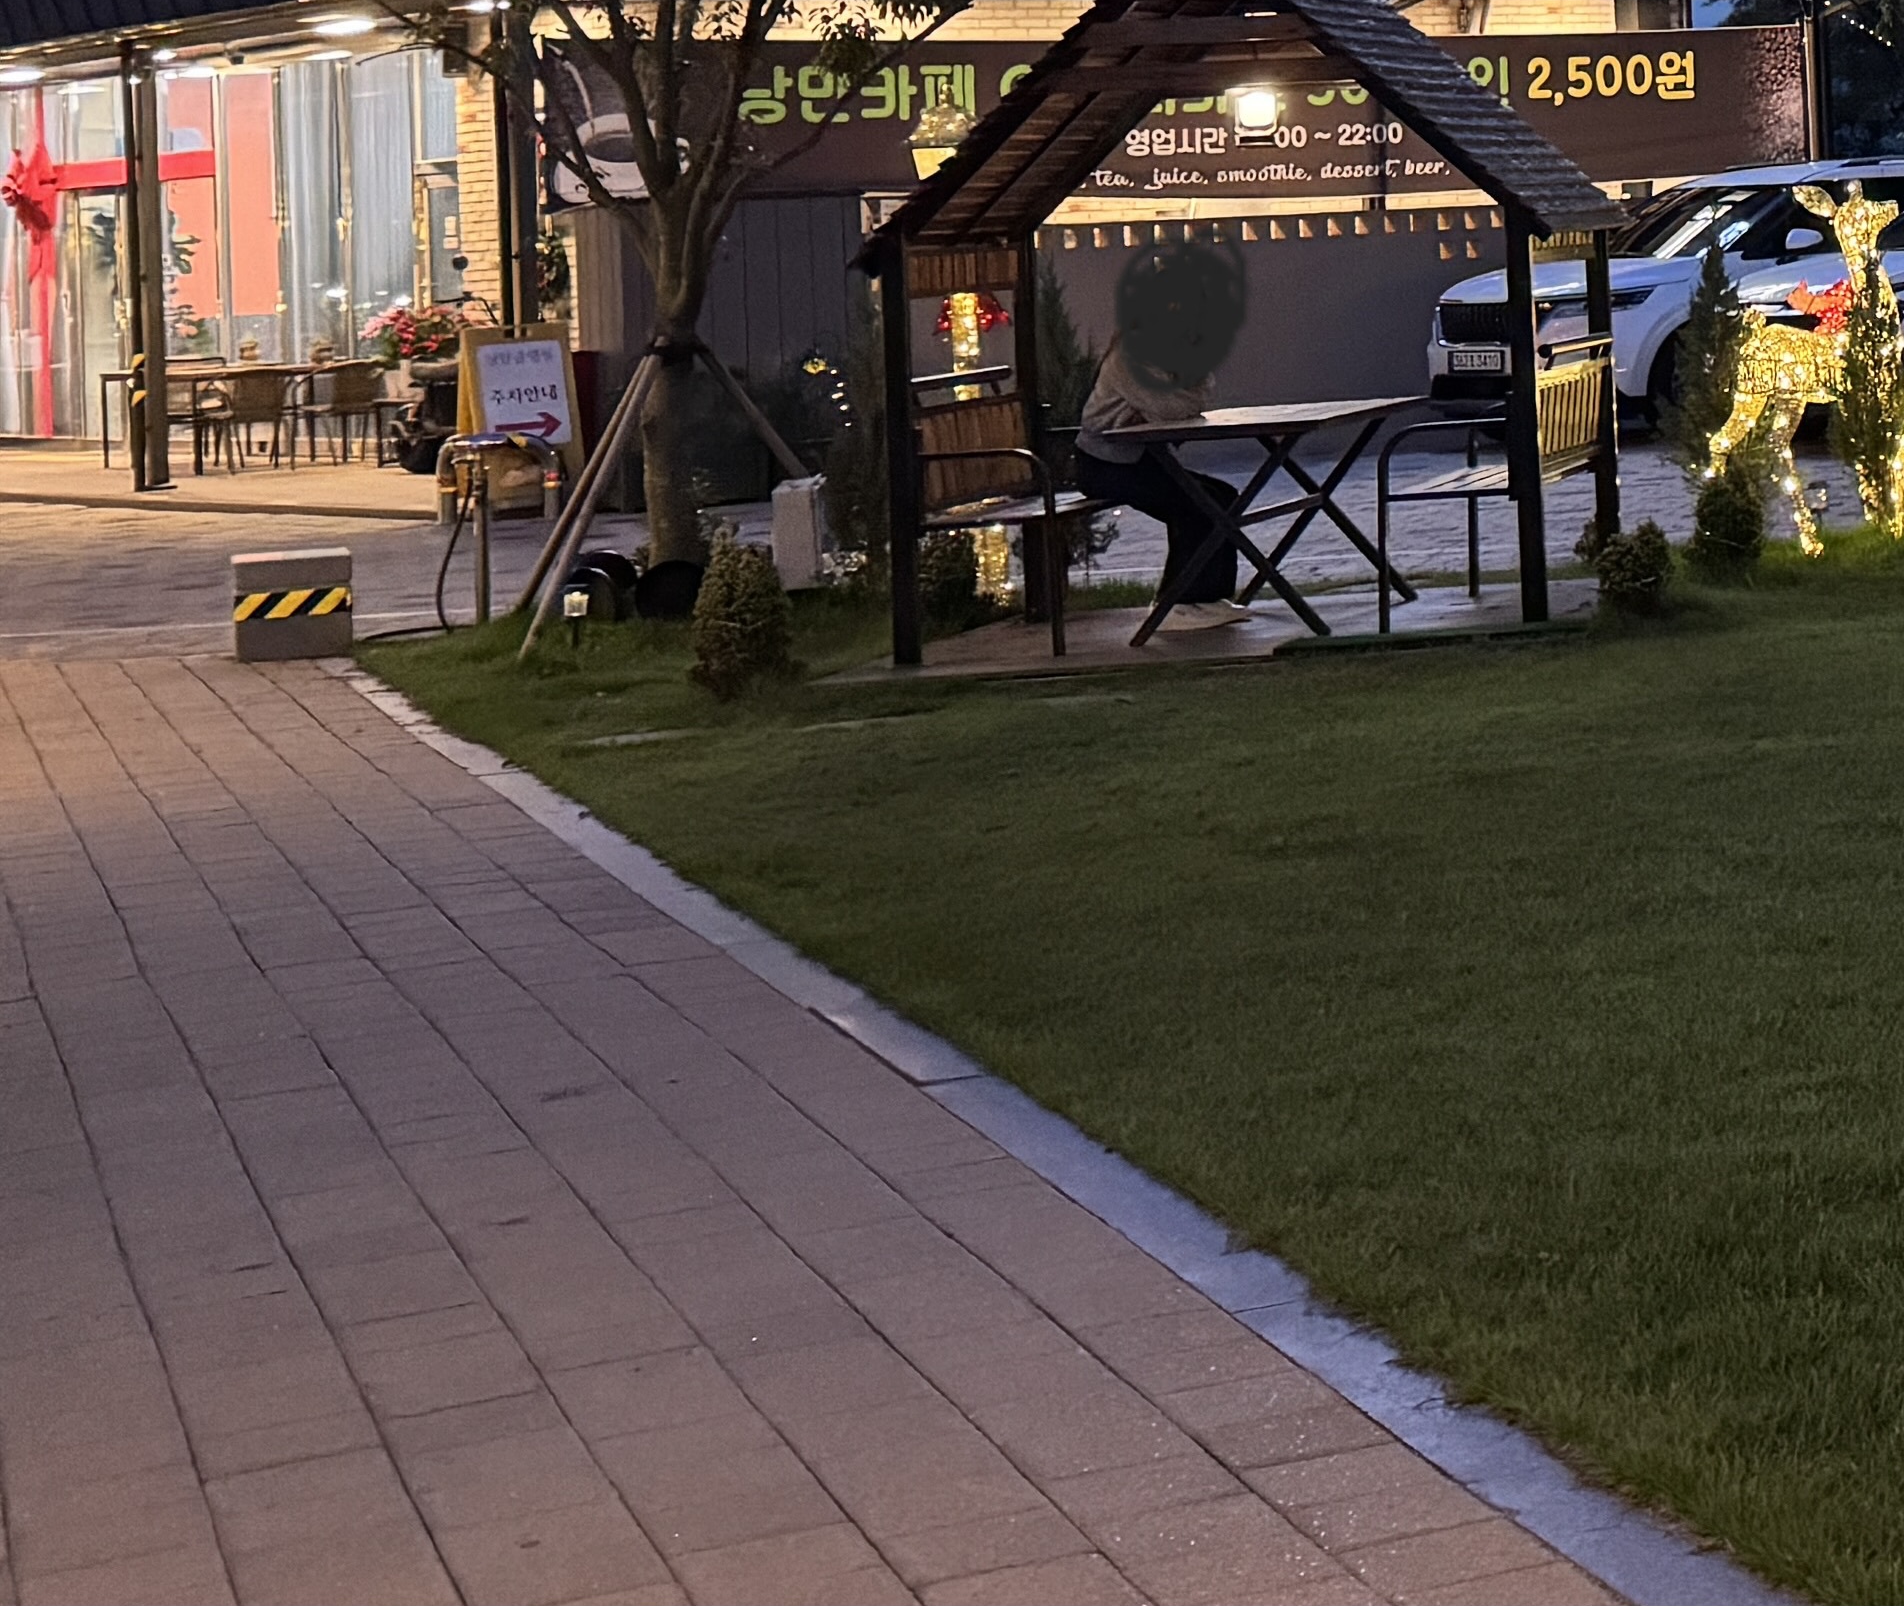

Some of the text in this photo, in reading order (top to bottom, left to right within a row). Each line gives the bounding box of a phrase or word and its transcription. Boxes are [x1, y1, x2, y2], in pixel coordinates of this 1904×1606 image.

[738, 64, 976, 124] 낭만카페
[1527, 50, 1695, 106] 2,500원
[1125, 127, 1228, 157] 영업시간
[1337, 122, 1403, 147] 22:00
[1143, 167, 1209, 190] juice,
[1217, 163, 1312, 184] smoothie,
[1404, 159, 1450, 176] beer,
